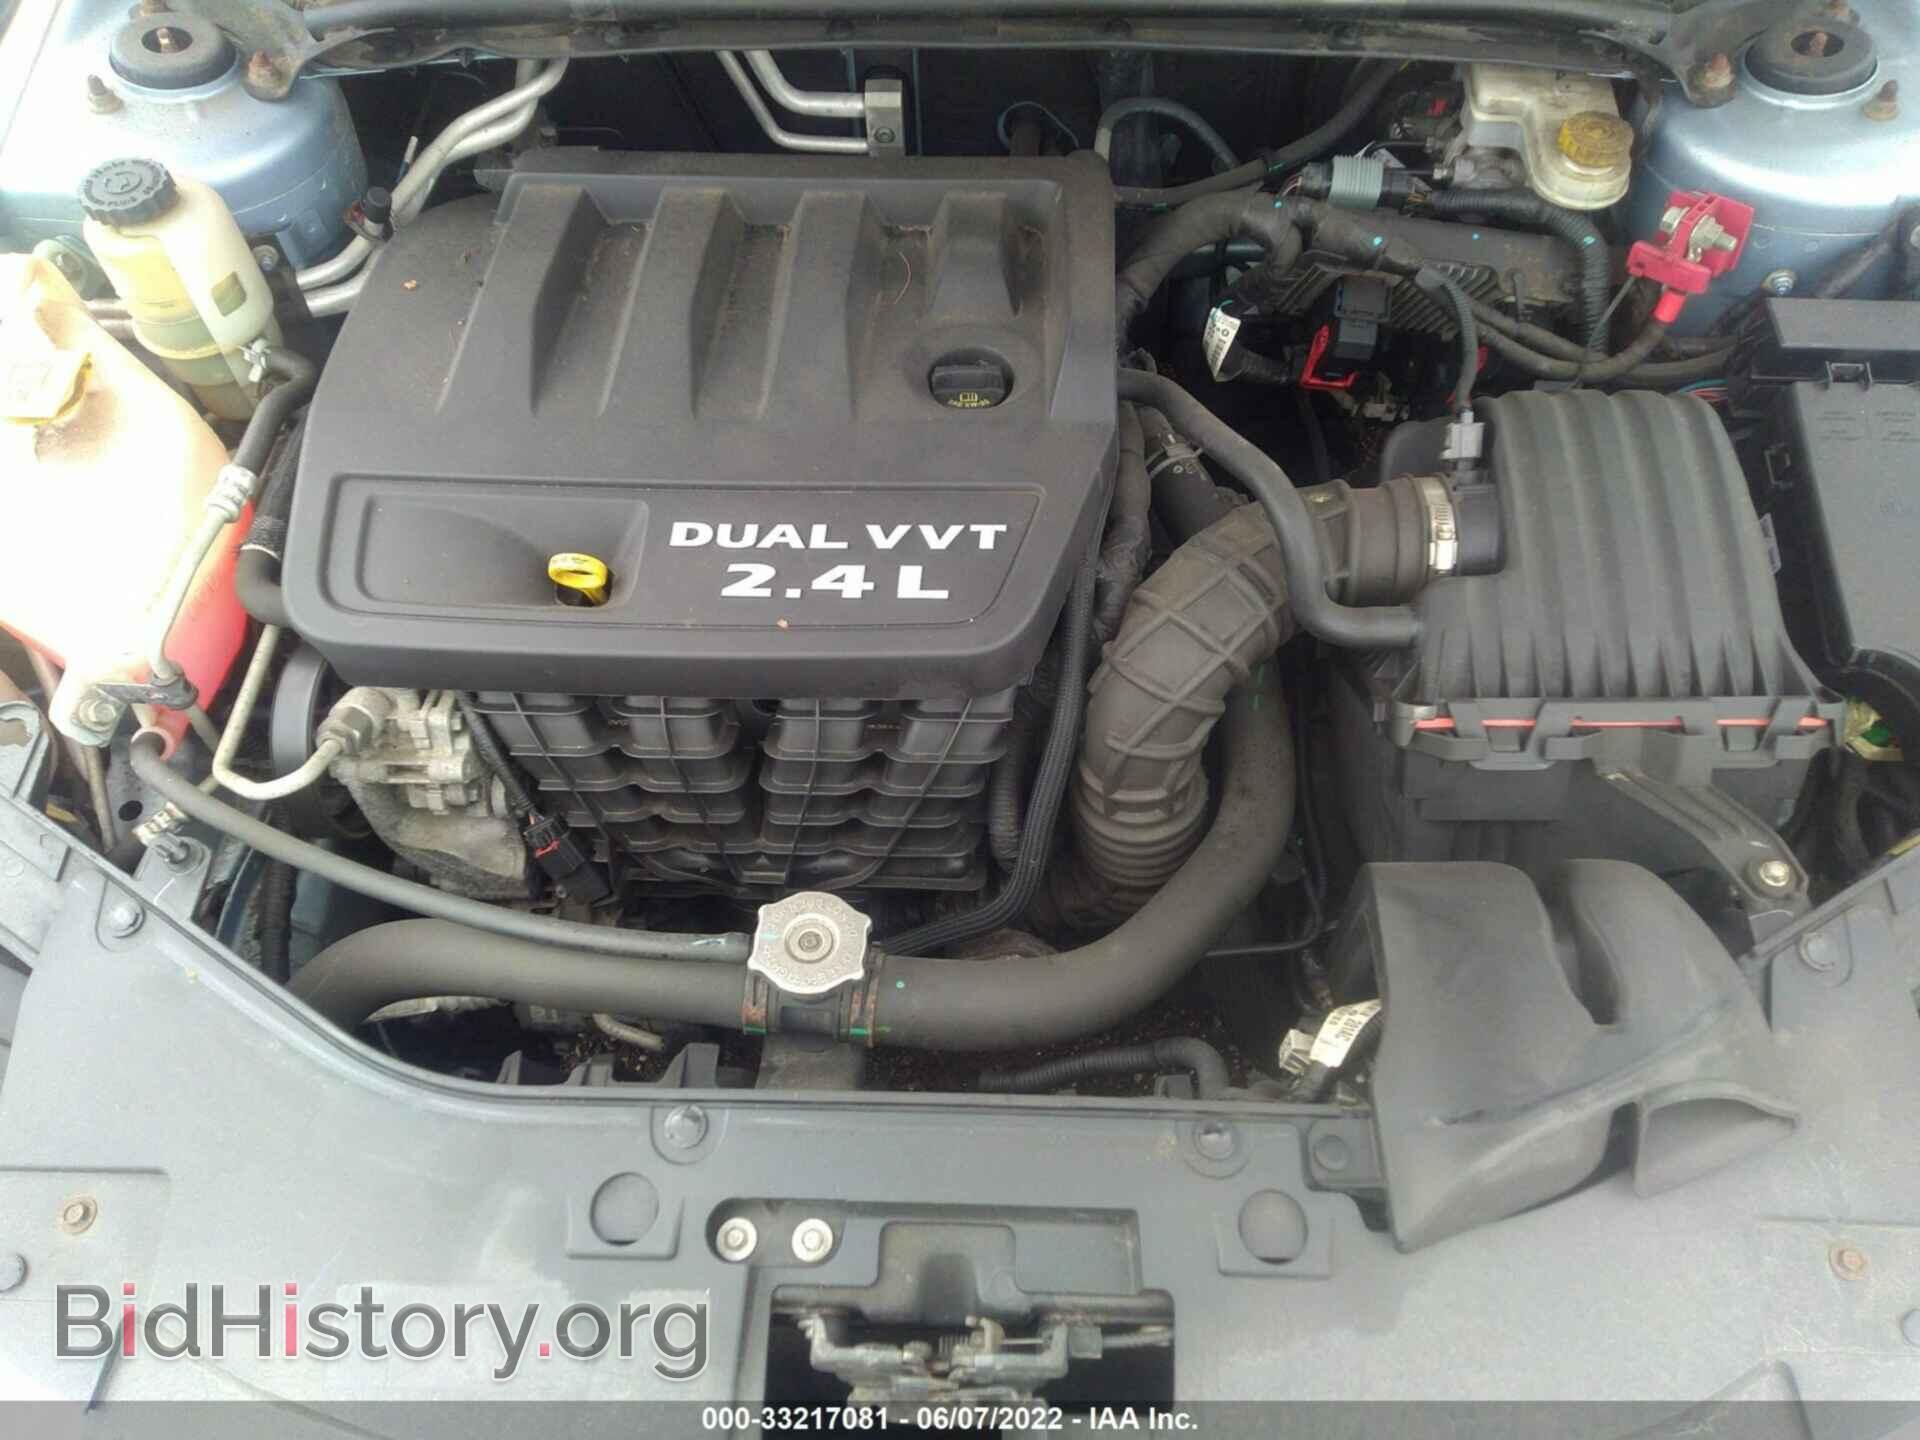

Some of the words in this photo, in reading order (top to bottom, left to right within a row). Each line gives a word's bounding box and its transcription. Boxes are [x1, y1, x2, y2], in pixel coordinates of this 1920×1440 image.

[669, 522, 849, 549] DUAL
[865, 524, 1007, 550] VVT
[719, 563, 875, 599] 2.4
[896, 563, 950, 600] L
